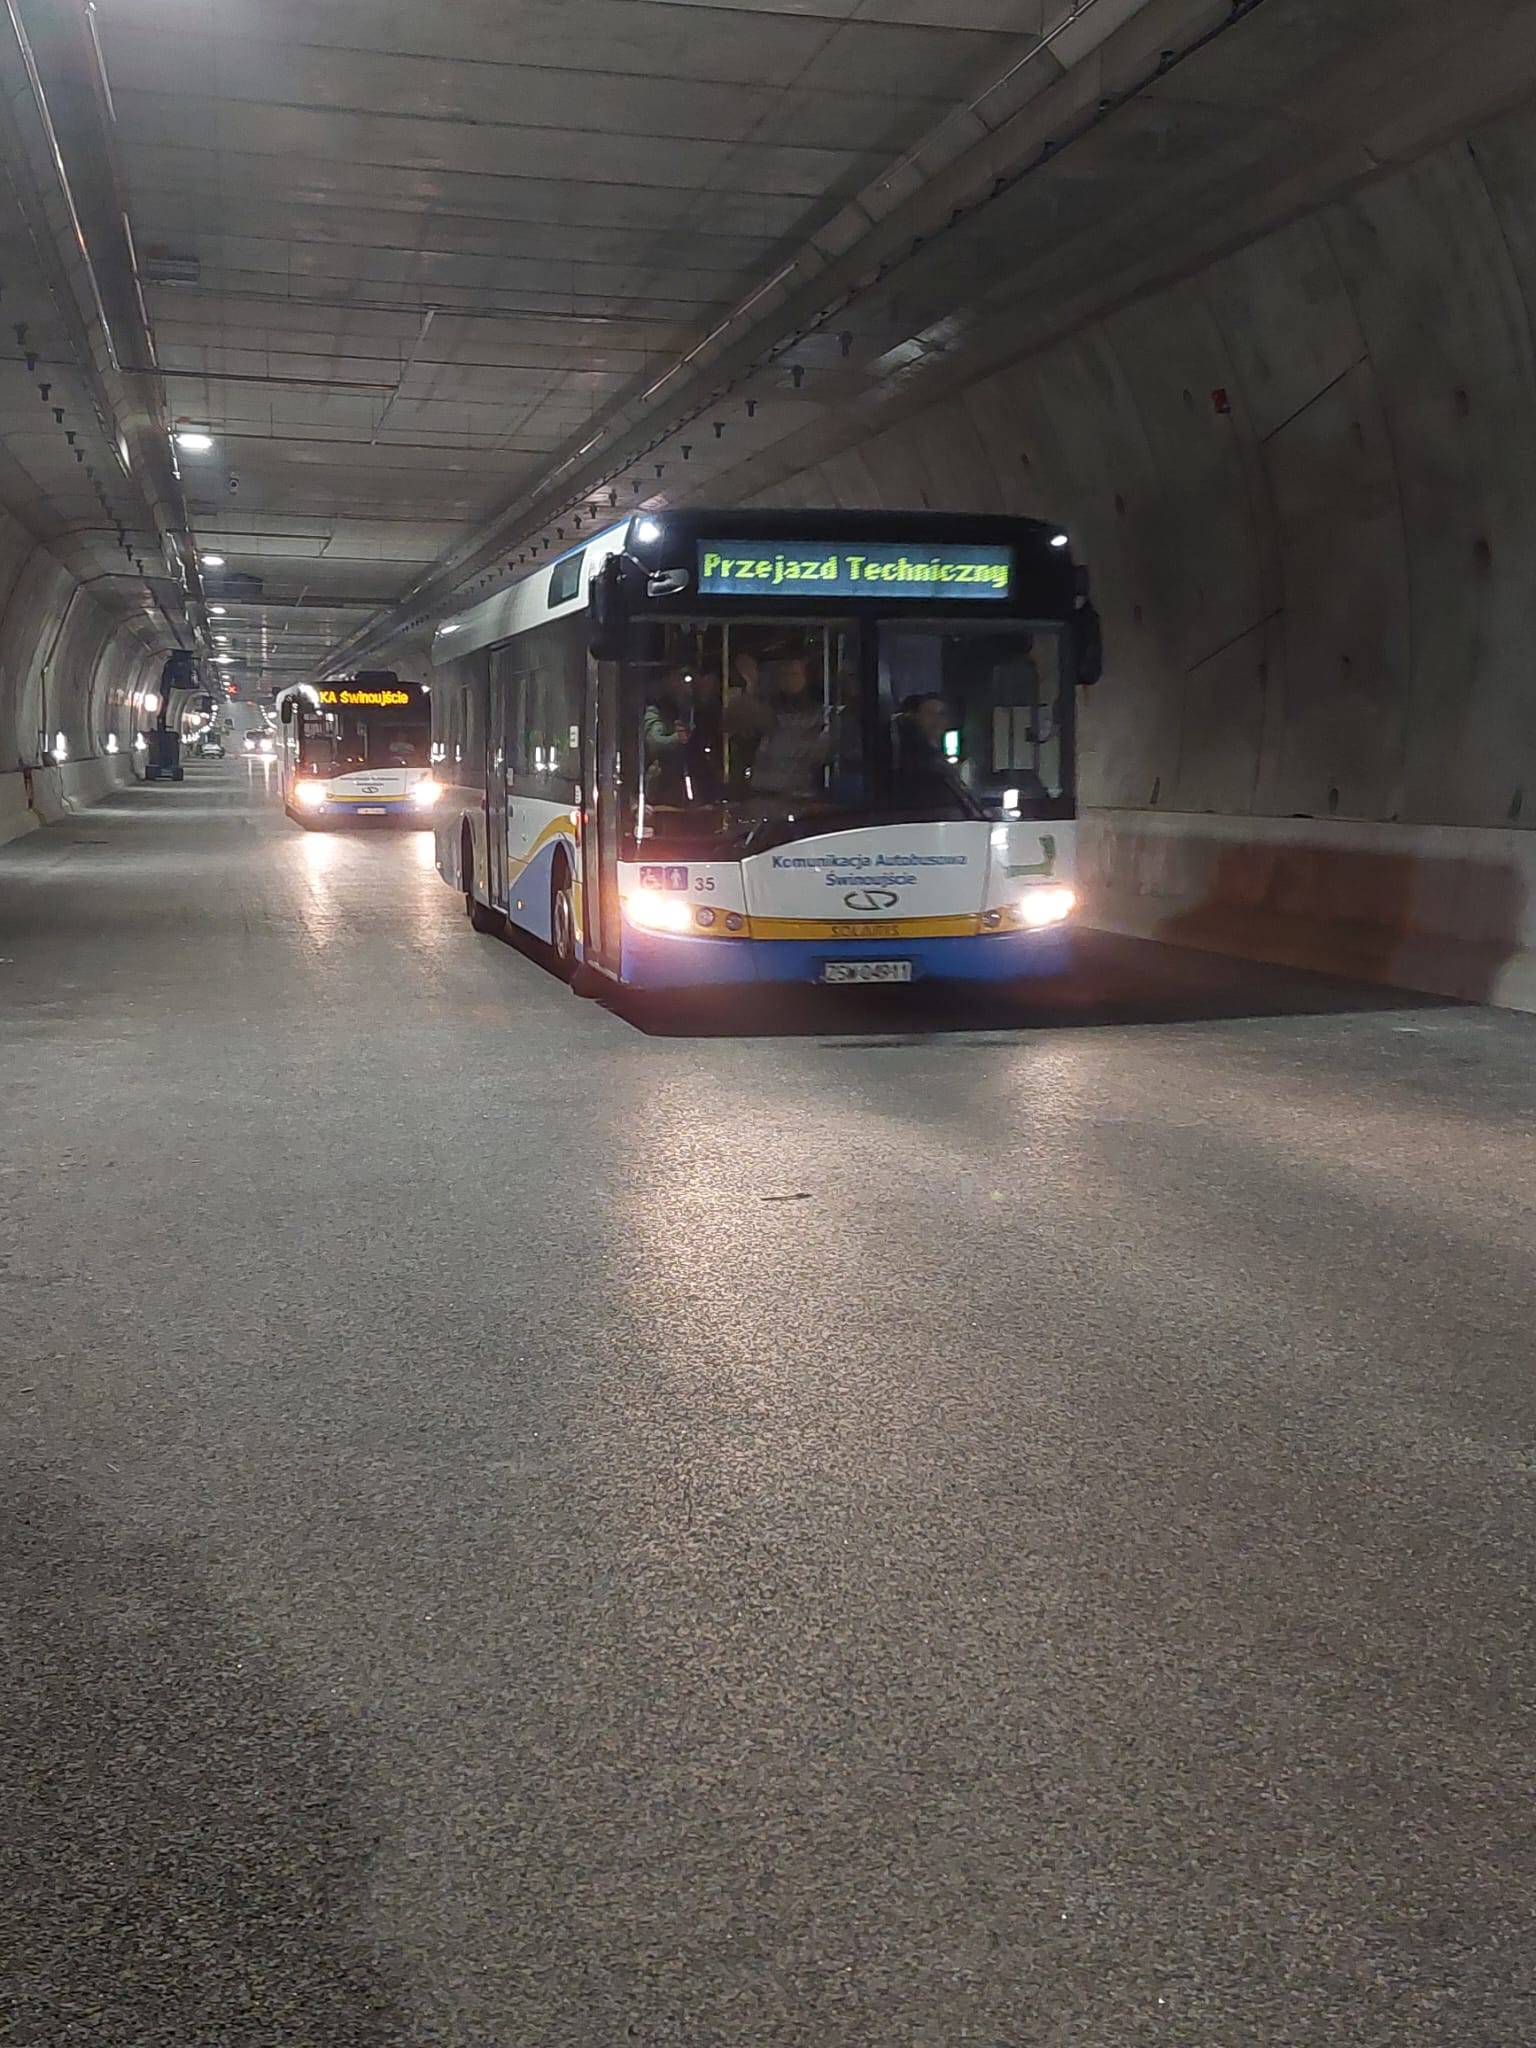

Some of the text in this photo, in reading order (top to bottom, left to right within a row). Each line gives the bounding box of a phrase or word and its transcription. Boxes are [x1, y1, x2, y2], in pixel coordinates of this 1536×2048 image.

[703, 553, 1009, 588] Przejazd Techniczny
[340, 690, 408, 707] Świnoujście
[772, 853, 968, 869] Komunikacja Autobusowa
[694, 877, 715, 891] 35
[825, 870, 917, 888] Świnoujście
